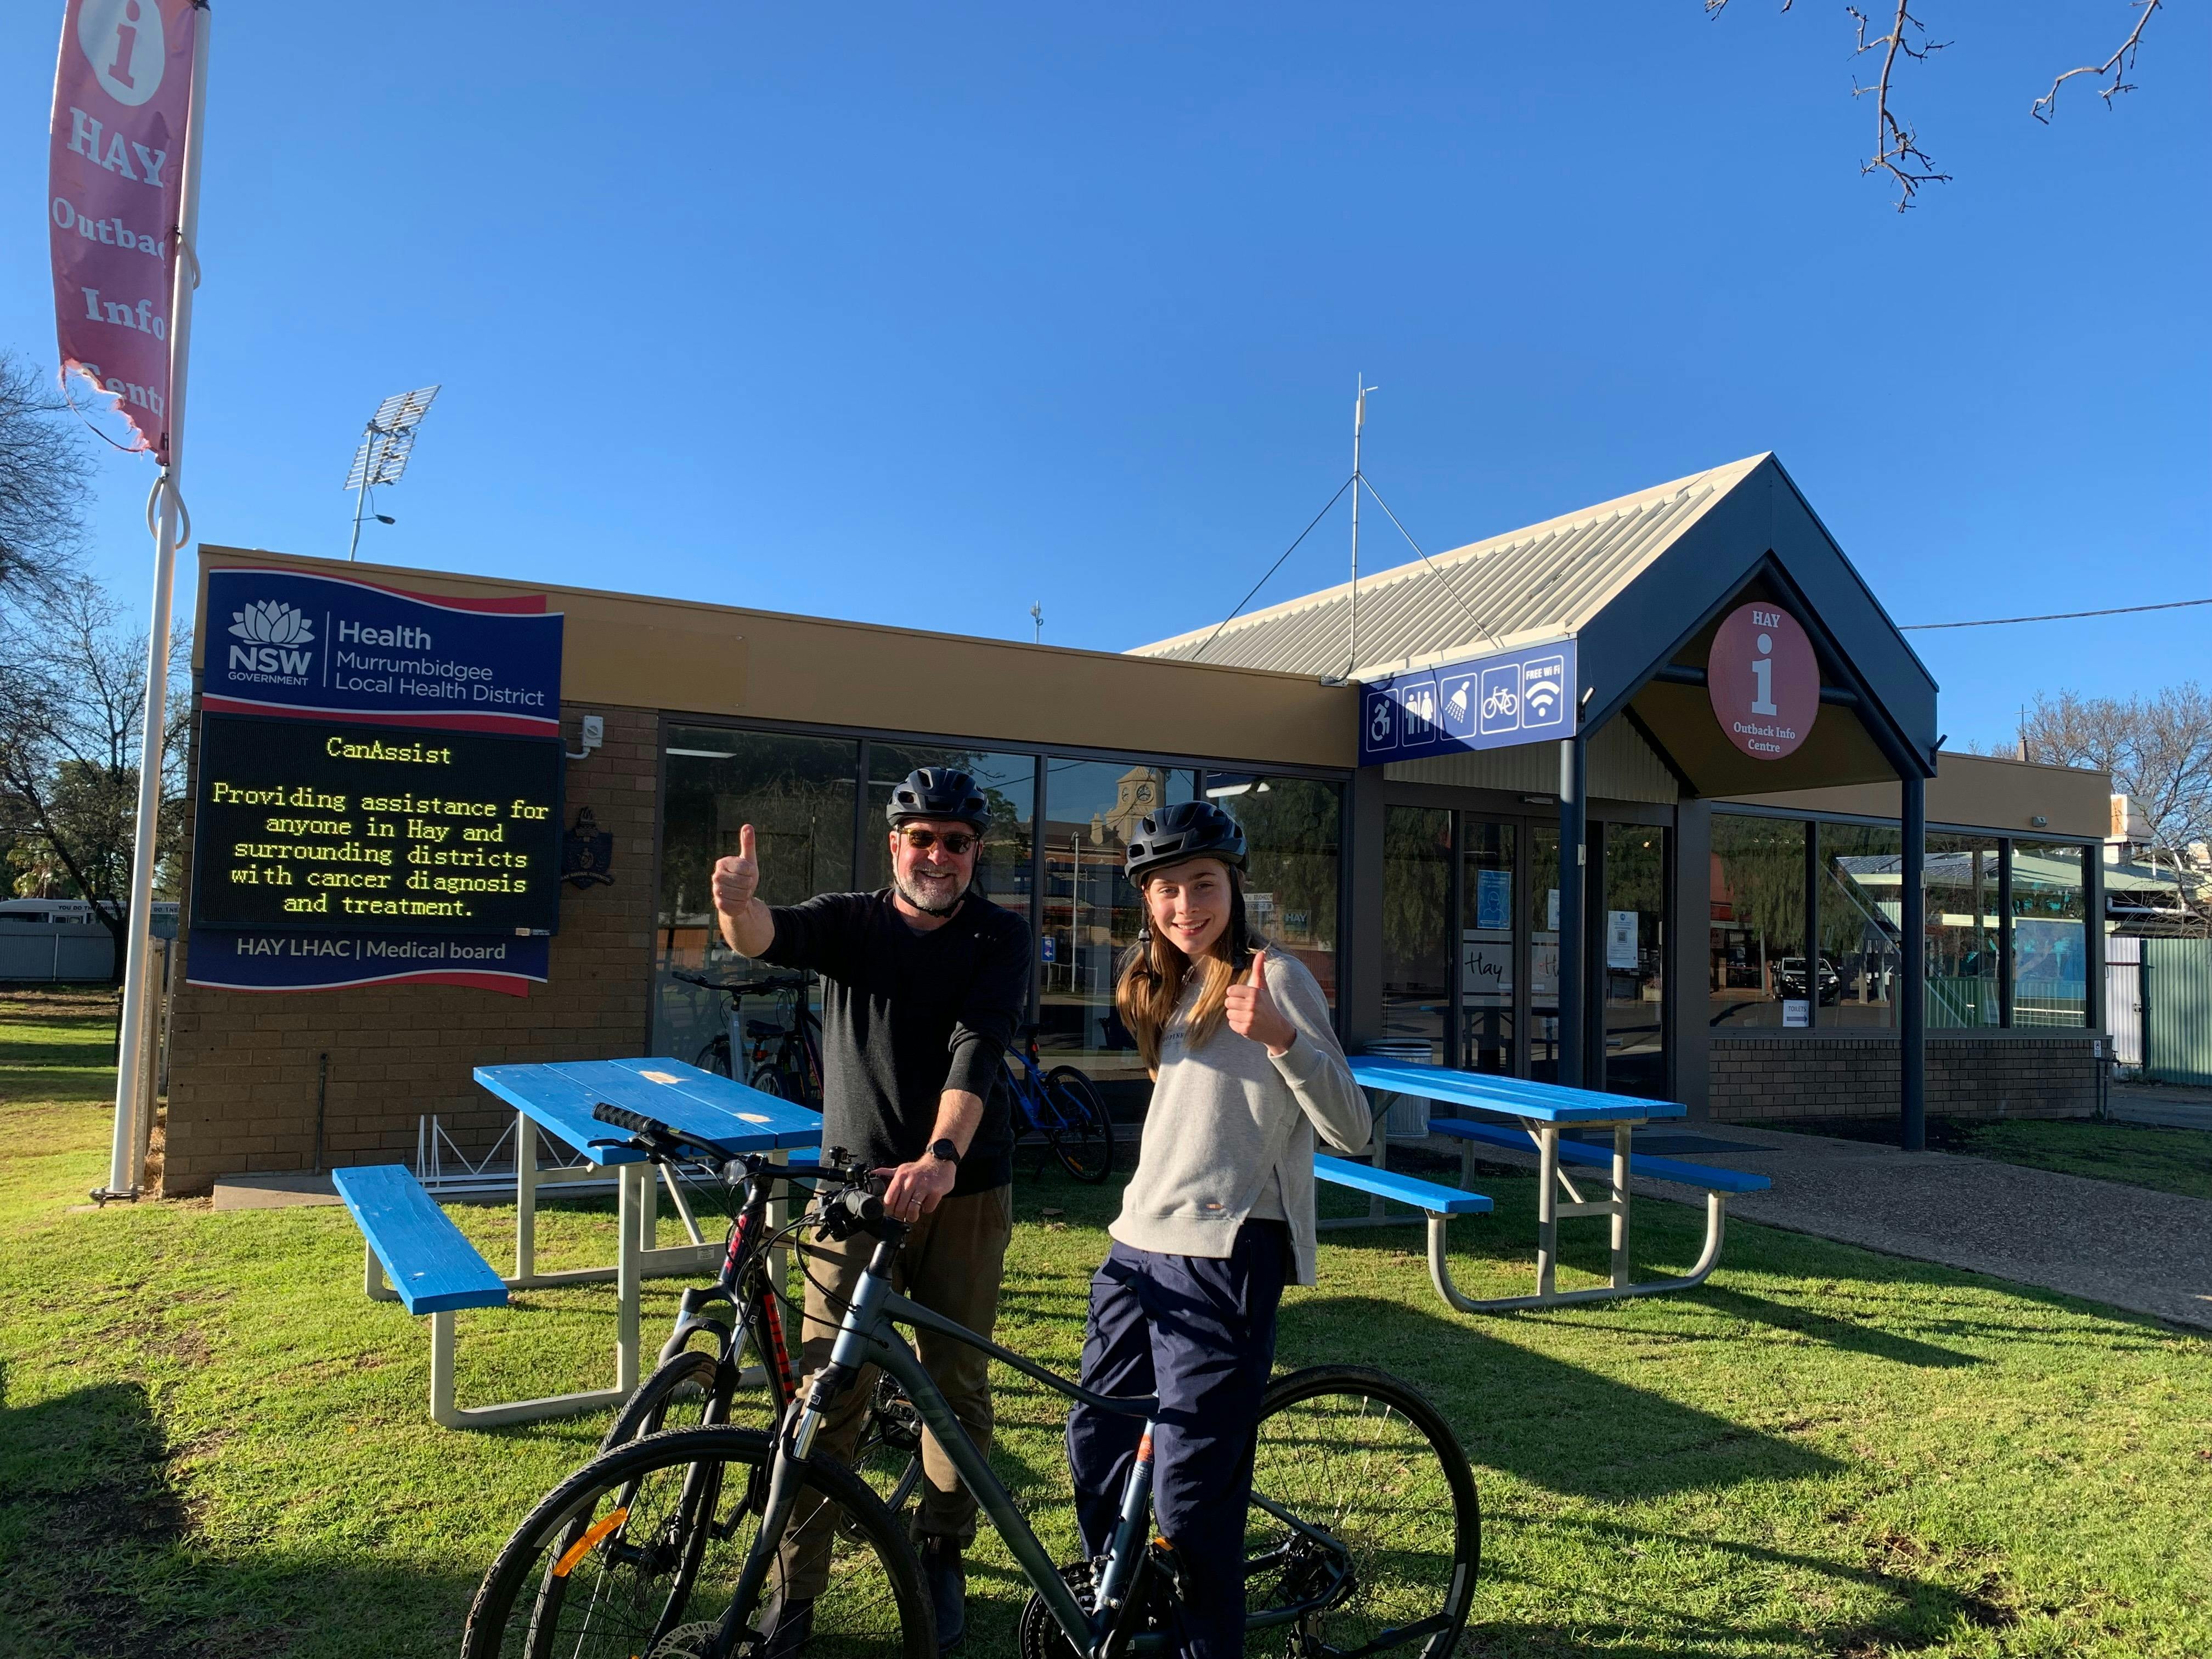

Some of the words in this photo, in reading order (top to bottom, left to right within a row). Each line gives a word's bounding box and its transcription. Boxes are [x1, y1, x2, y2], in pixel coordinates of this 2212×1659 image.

[67, 106, 166, 188] HAY
[81, 287, 165, 341] Info
[1752, 610, 1781, 628] HAY
[338, 620, 432, 650] Health
[228, 645, 312, 675] NSW
[336, 651, 493, 682] Murrumbidgee
[1526, 668, 1542, 680] FREE
[1543, 666, 1553, 676] Wi
[1553, 665, 1561, 675] Fi
[228, 672, 308, 686] GOVERNMENT
[336, 673, 393, 694] Local
[400, 675, 467, 701] Health
[473, 685, 545, 707] District
[1733, 721, 1774, 737] Outback
[1776, 727, 1796, 739] Info
[327, 737, 451, 764] CanAssist
[1748, 738, 1781, 753] Centre
[212, 782, 346, 812] Providing
[361, 793, 496, 817] assistance
[510, 799, 549, 820] for
[266, 818, 352, 836] anyone
[366, 817, 395, 837] in
[407, 819, 450, 843] Hay
[462, 823, 504, 842] and
[234, 842, 392, 866] surrounding
[407, 845, 528, 868] districts
[230, 864, 292, 885] with
[307, 871, 392, 888] cancer
[405, 871, 527, 894] diagnosis
[283, 893, 328, 913] and
[342, 897, 473, 917] treatment.
[237, 937, 285, 956] HAY
[290, 939, 351, 958] LHAC
[366, 940, 445, 959] Medical
[449, 943, 506, 961] board
[1465, 951, 1503, 983] Hay
